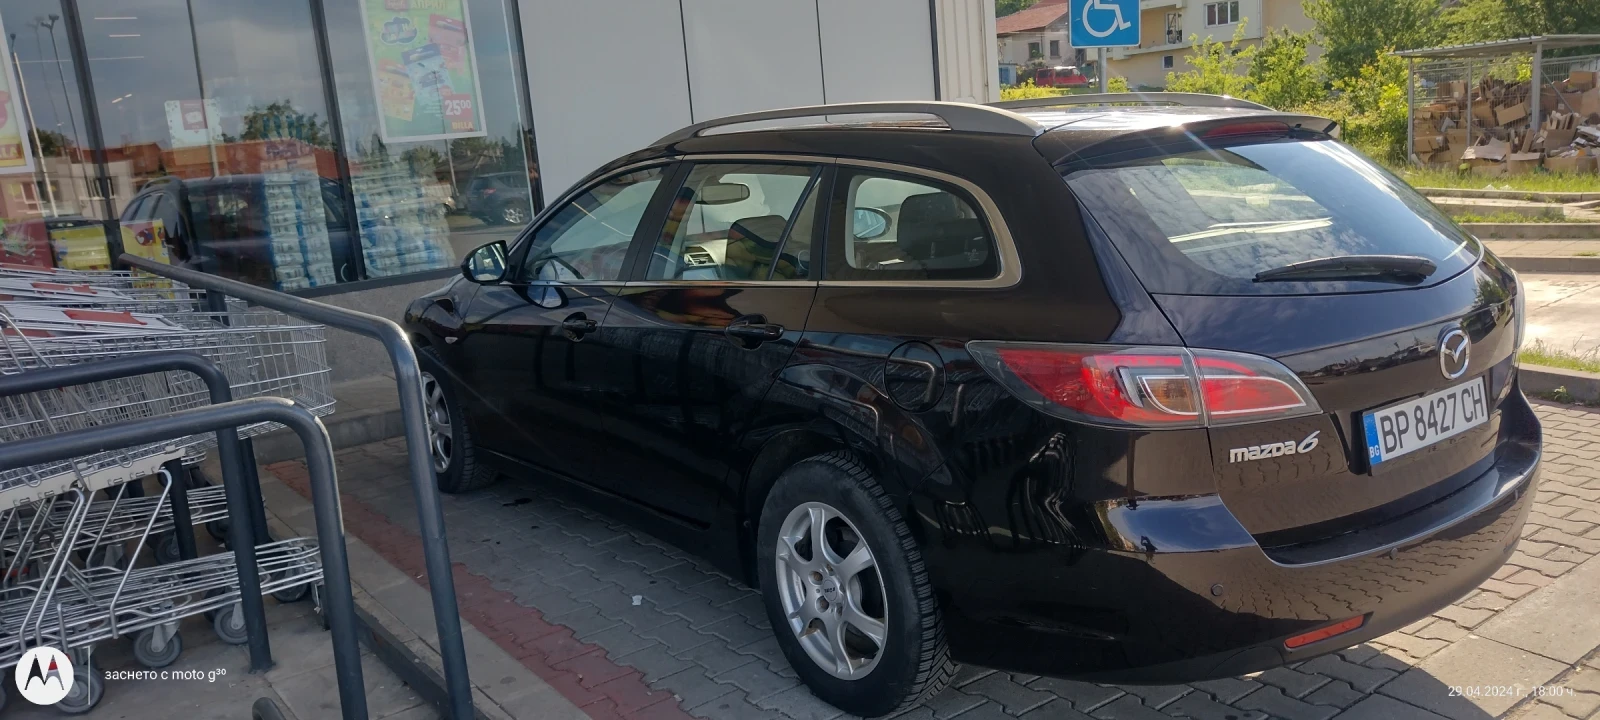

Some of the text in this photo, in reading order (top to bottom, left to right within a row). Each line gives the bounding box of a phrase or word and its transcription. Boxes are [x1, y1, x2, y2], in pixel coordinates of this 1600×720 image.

[1380, 383, 1484, 454] BP 8427 CH
[1369, 444, 1380, 458] BG
